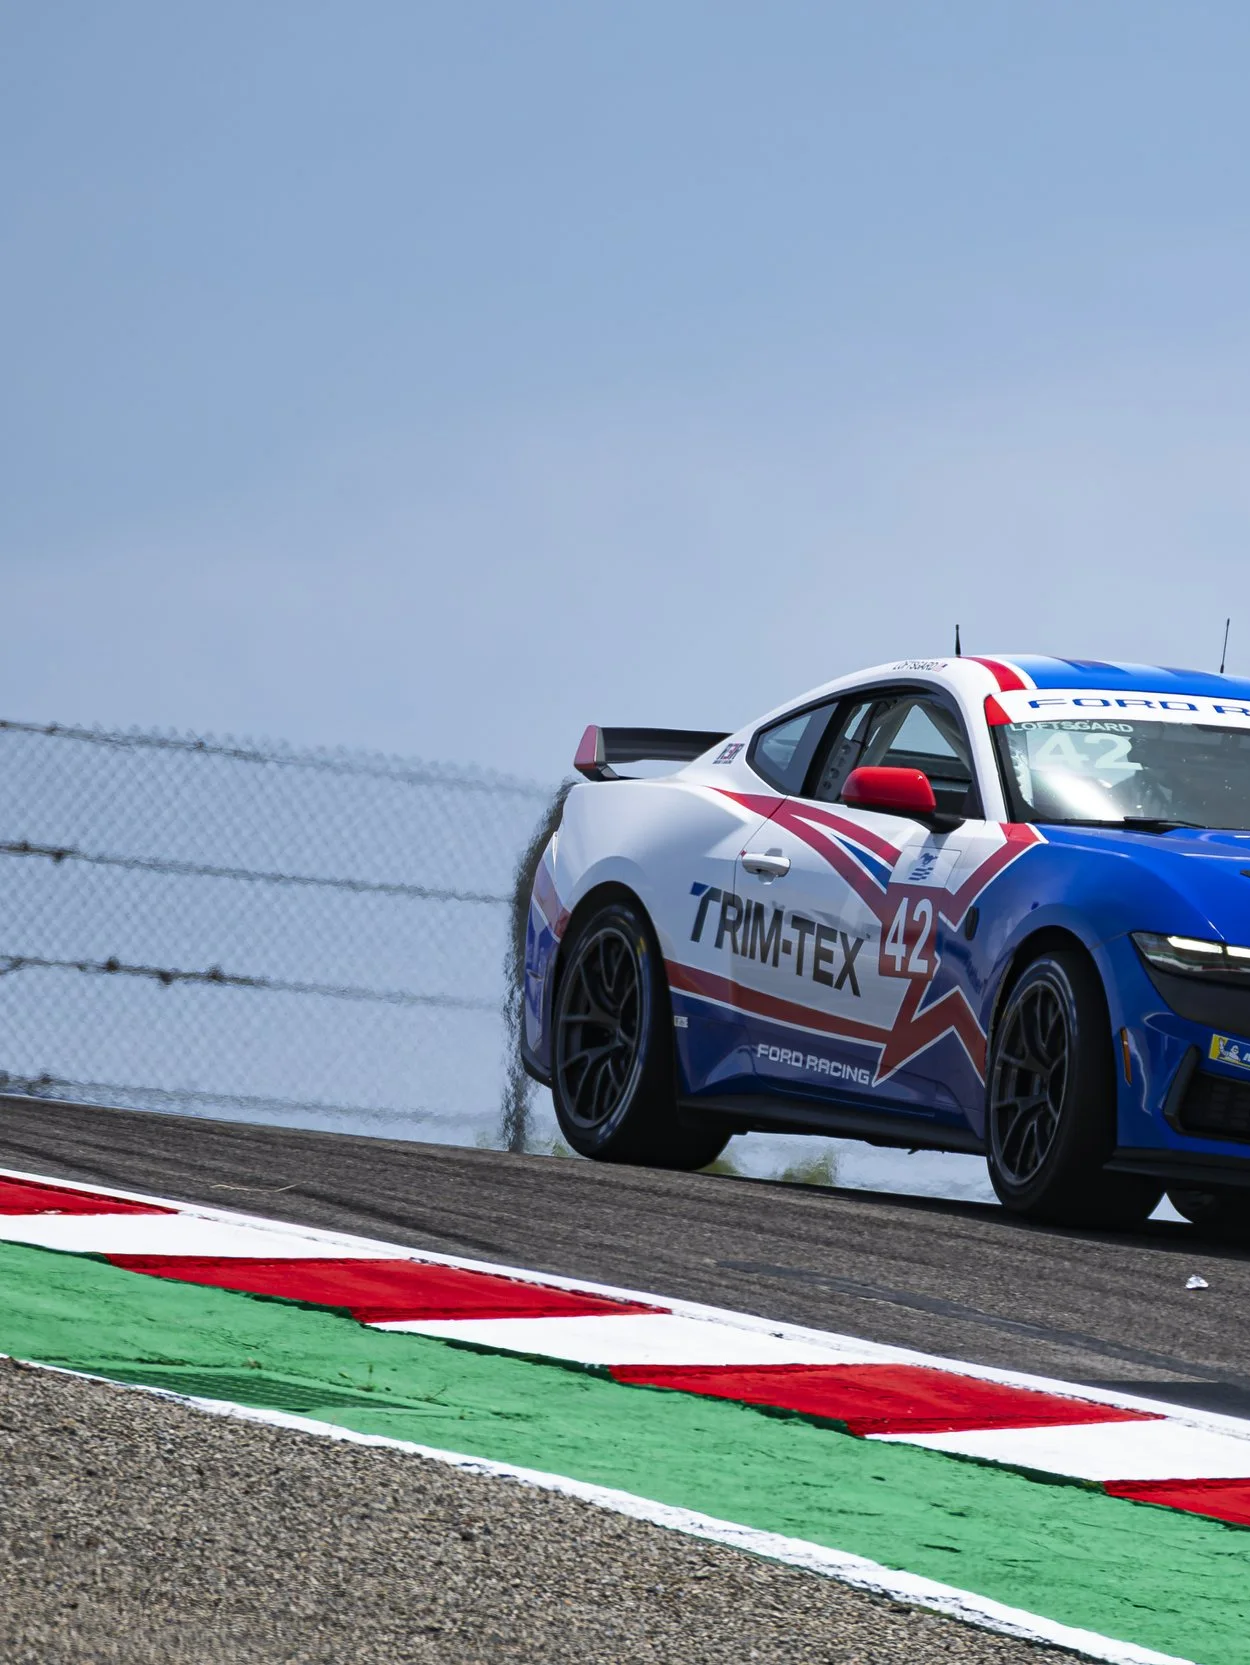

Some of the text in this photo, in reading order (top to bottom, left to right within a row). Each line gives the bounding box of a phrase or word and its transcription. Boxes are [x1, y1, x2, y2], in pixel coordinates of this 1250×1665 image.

[1028, 698, 1200, 712] FORD
[1009, 721, 1134, 733] LOFTSGARD
[1034, 732, 1144, 771] 42
[689, 881, 865, 998] TRIM-TEX
[884, 897, 933, 974] 42
[757, 1043, 870, 1085] FORD RACING
